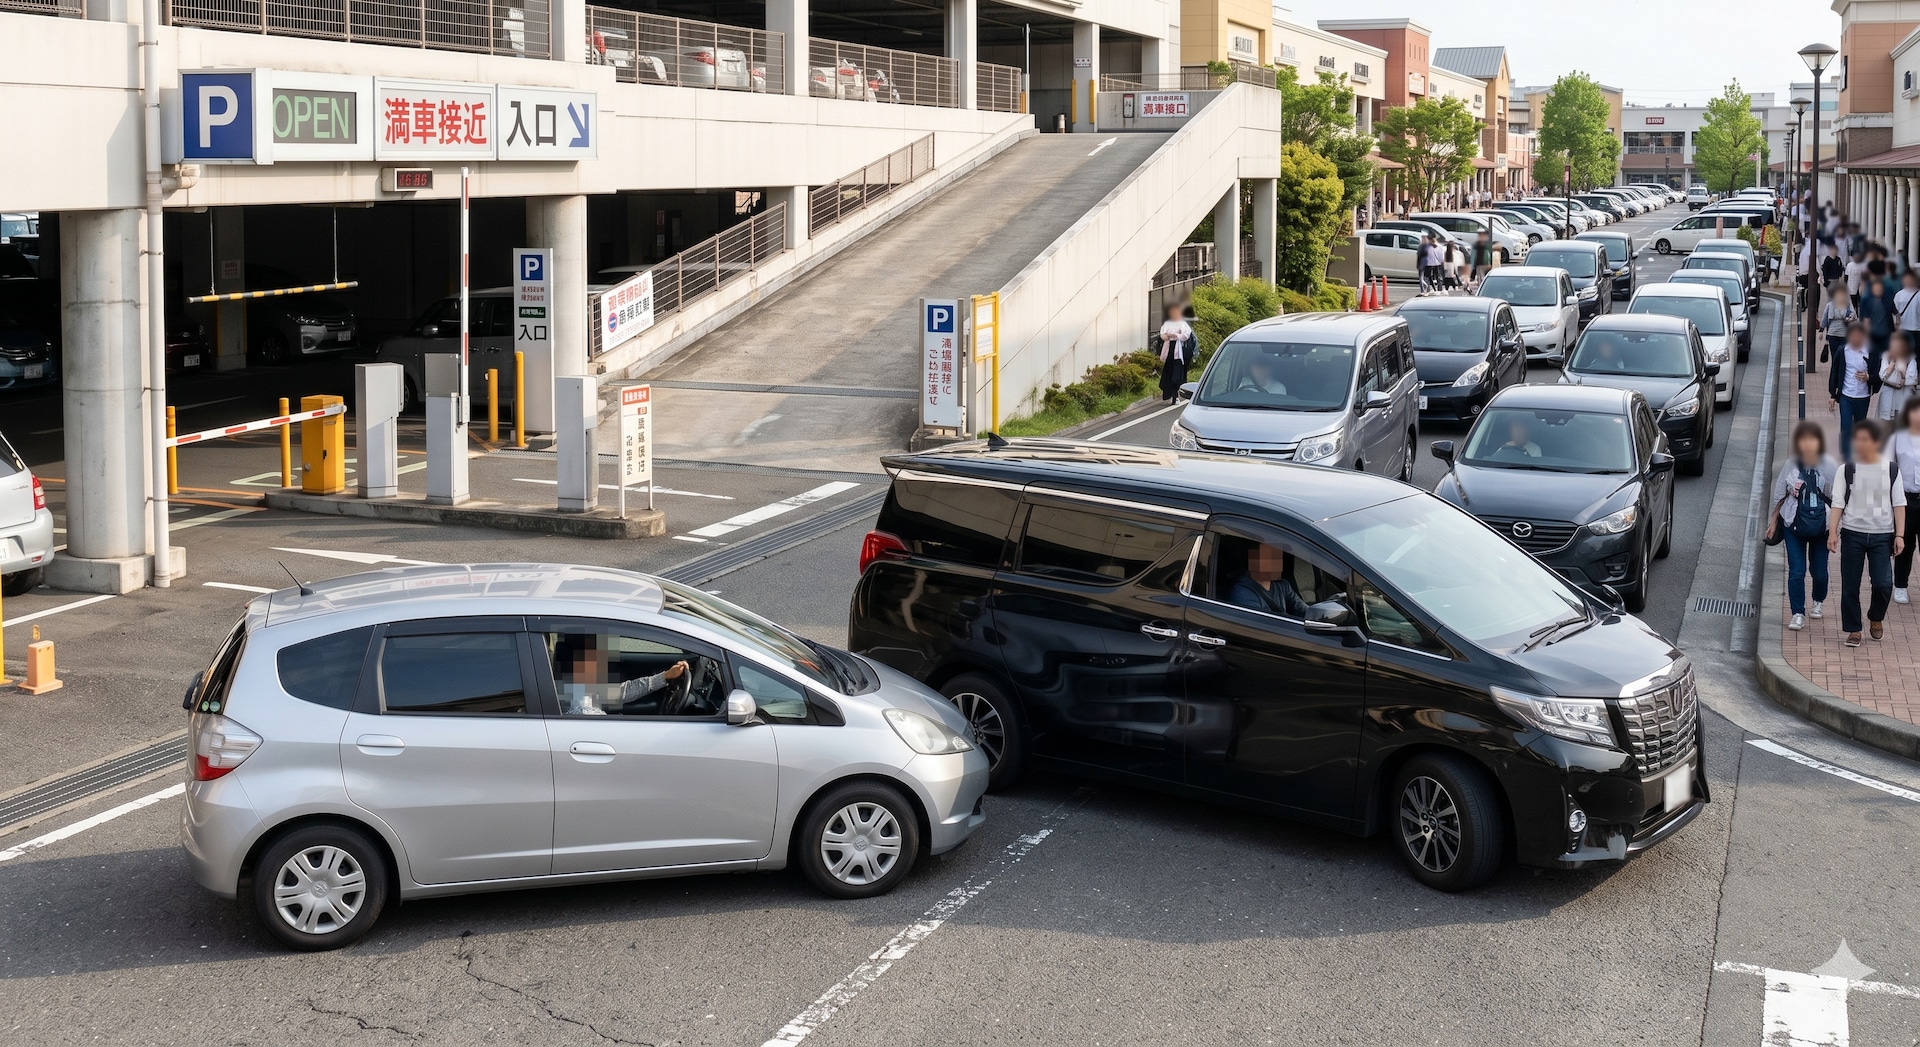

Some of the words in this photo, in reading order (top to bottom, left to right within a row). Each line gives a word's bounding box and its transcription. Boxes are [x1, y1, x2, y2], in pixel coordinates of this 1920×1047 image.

[198, 85, 239, 148] P
[272, 94, 350, 139] OPEN
[384, 97, 488, 145] 満車接近
[506, 100, 557, 148] 入口
[525, 257, 540, 278] P
[518, 324, 547, 341] 入口
[932, 307, 949, 330] P
